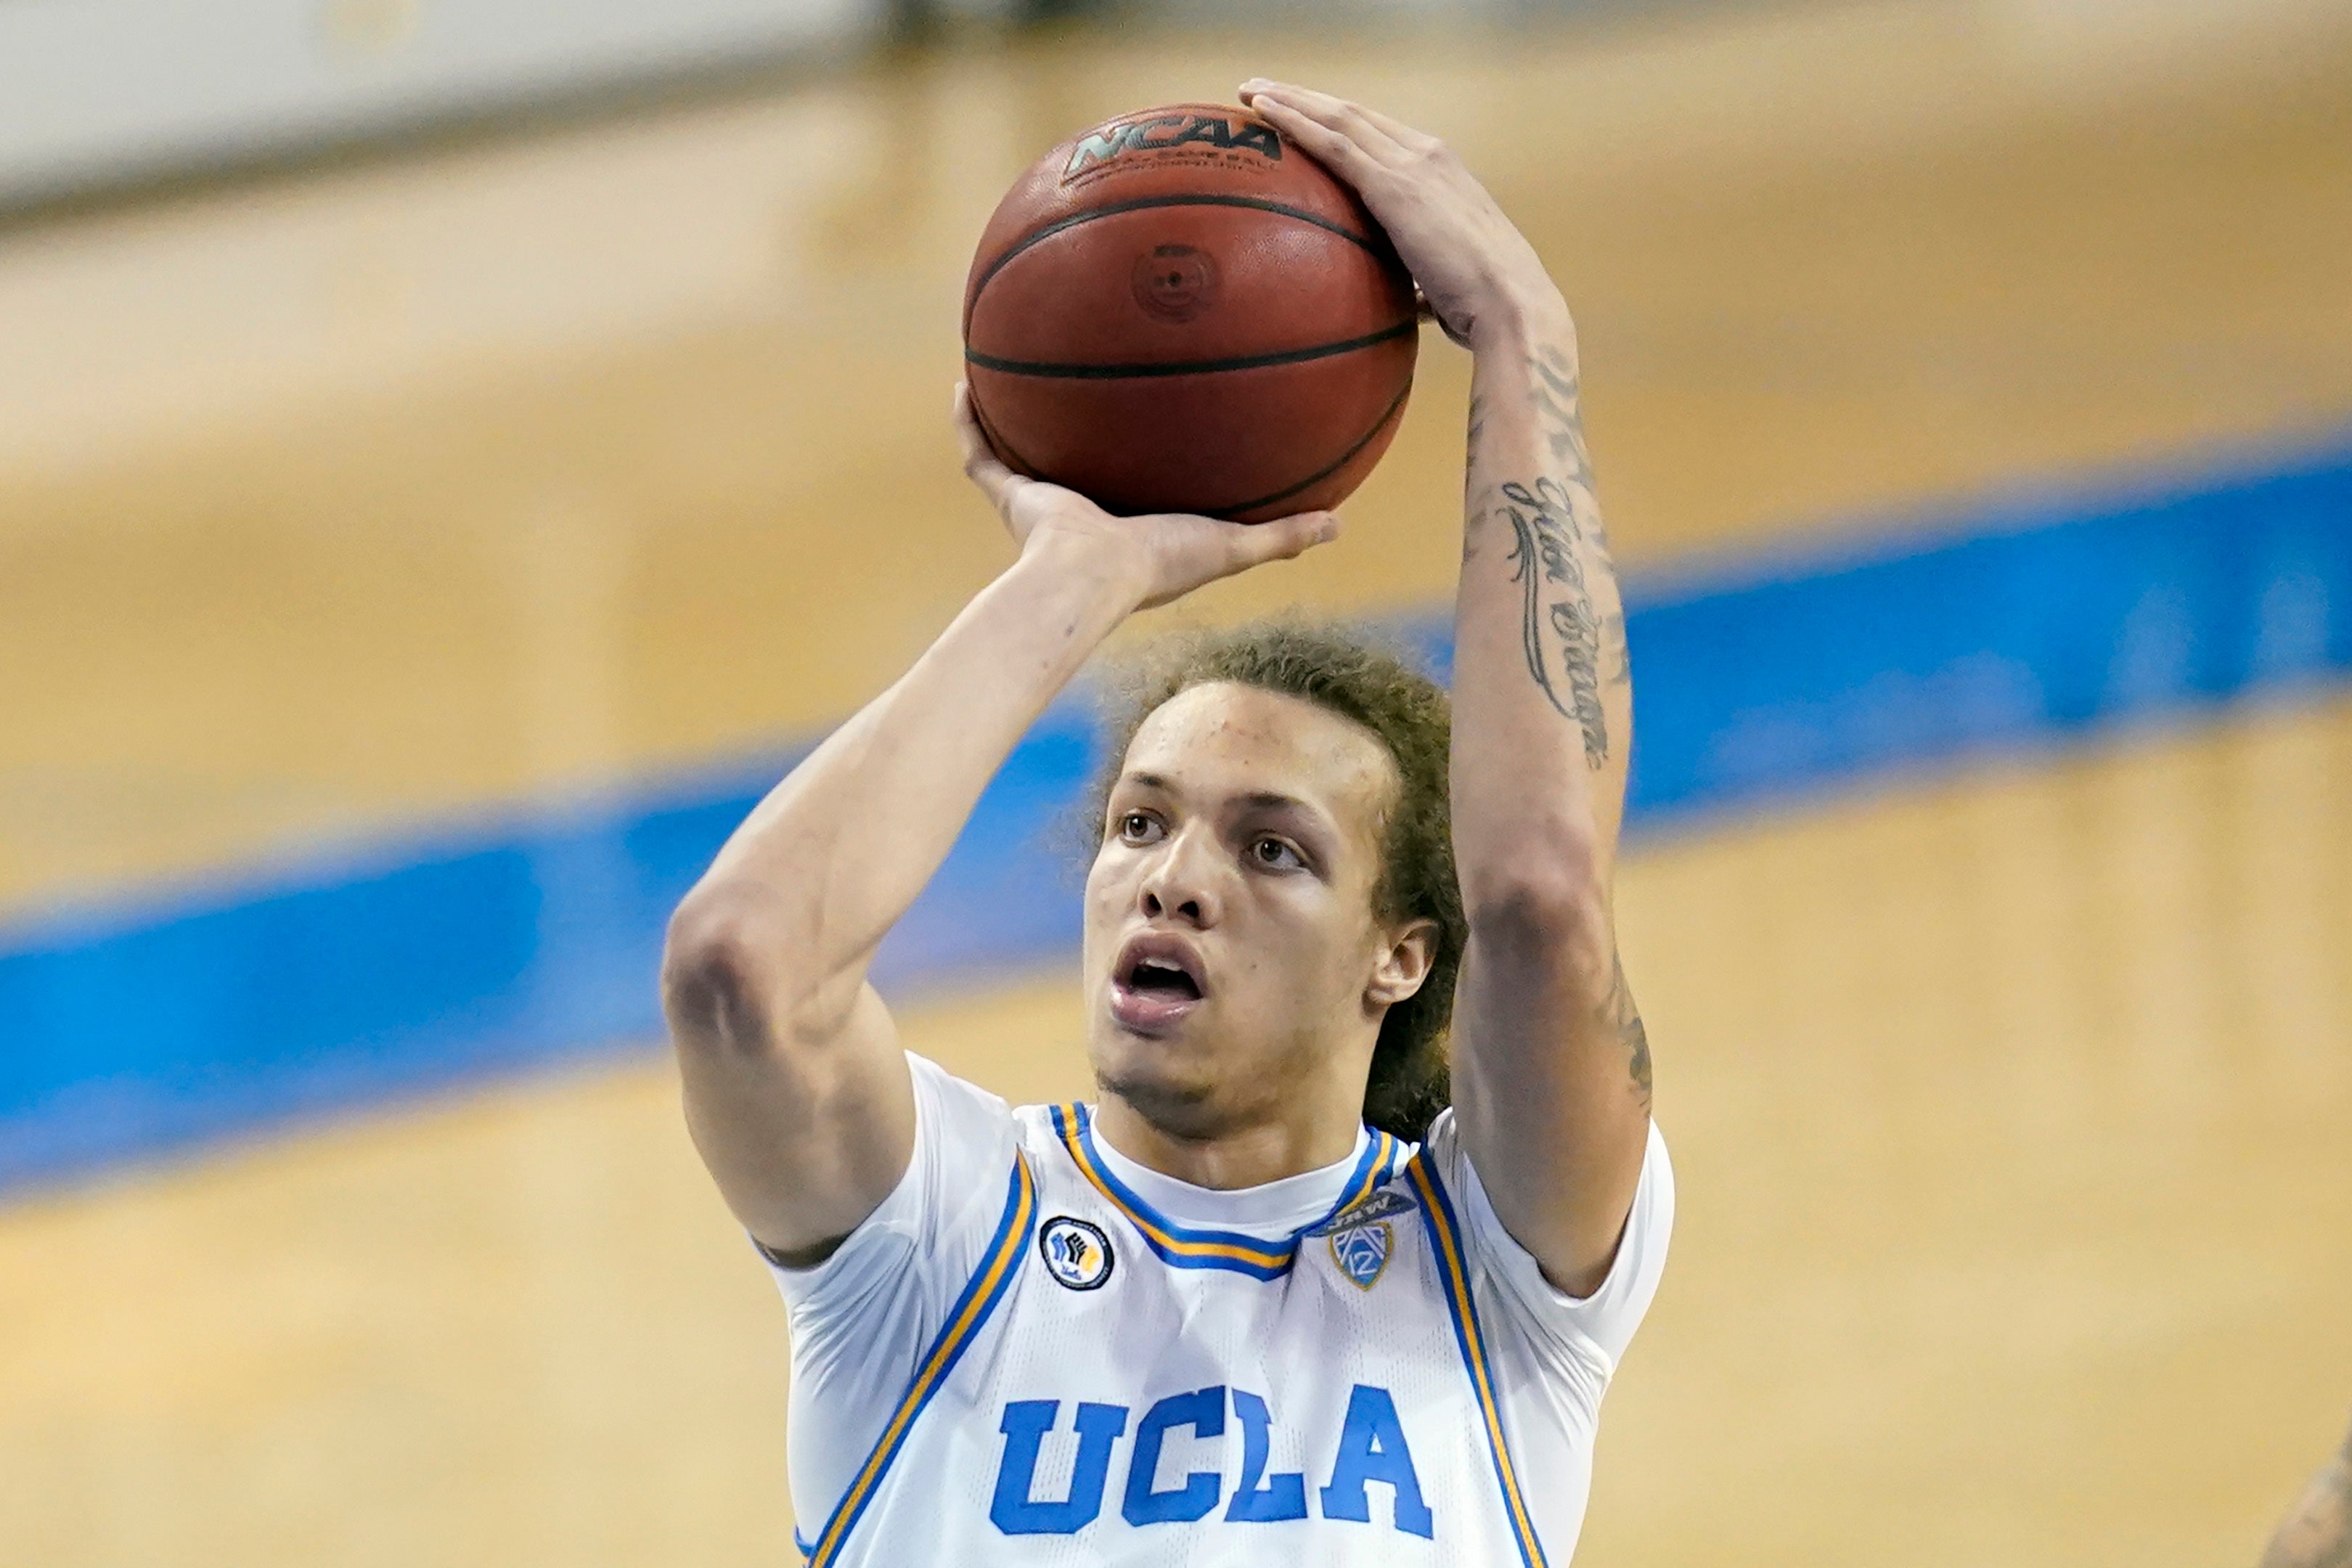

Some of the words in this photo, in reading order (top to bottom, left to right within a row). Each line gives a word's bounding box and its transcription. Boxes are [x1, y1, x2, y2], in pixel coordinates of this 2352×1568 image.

[1063, 116, 1283, 174] NCAA
[1348, 1250, 1379, 1277] 12
[989, 1384, 1434, 1540] UCLA
